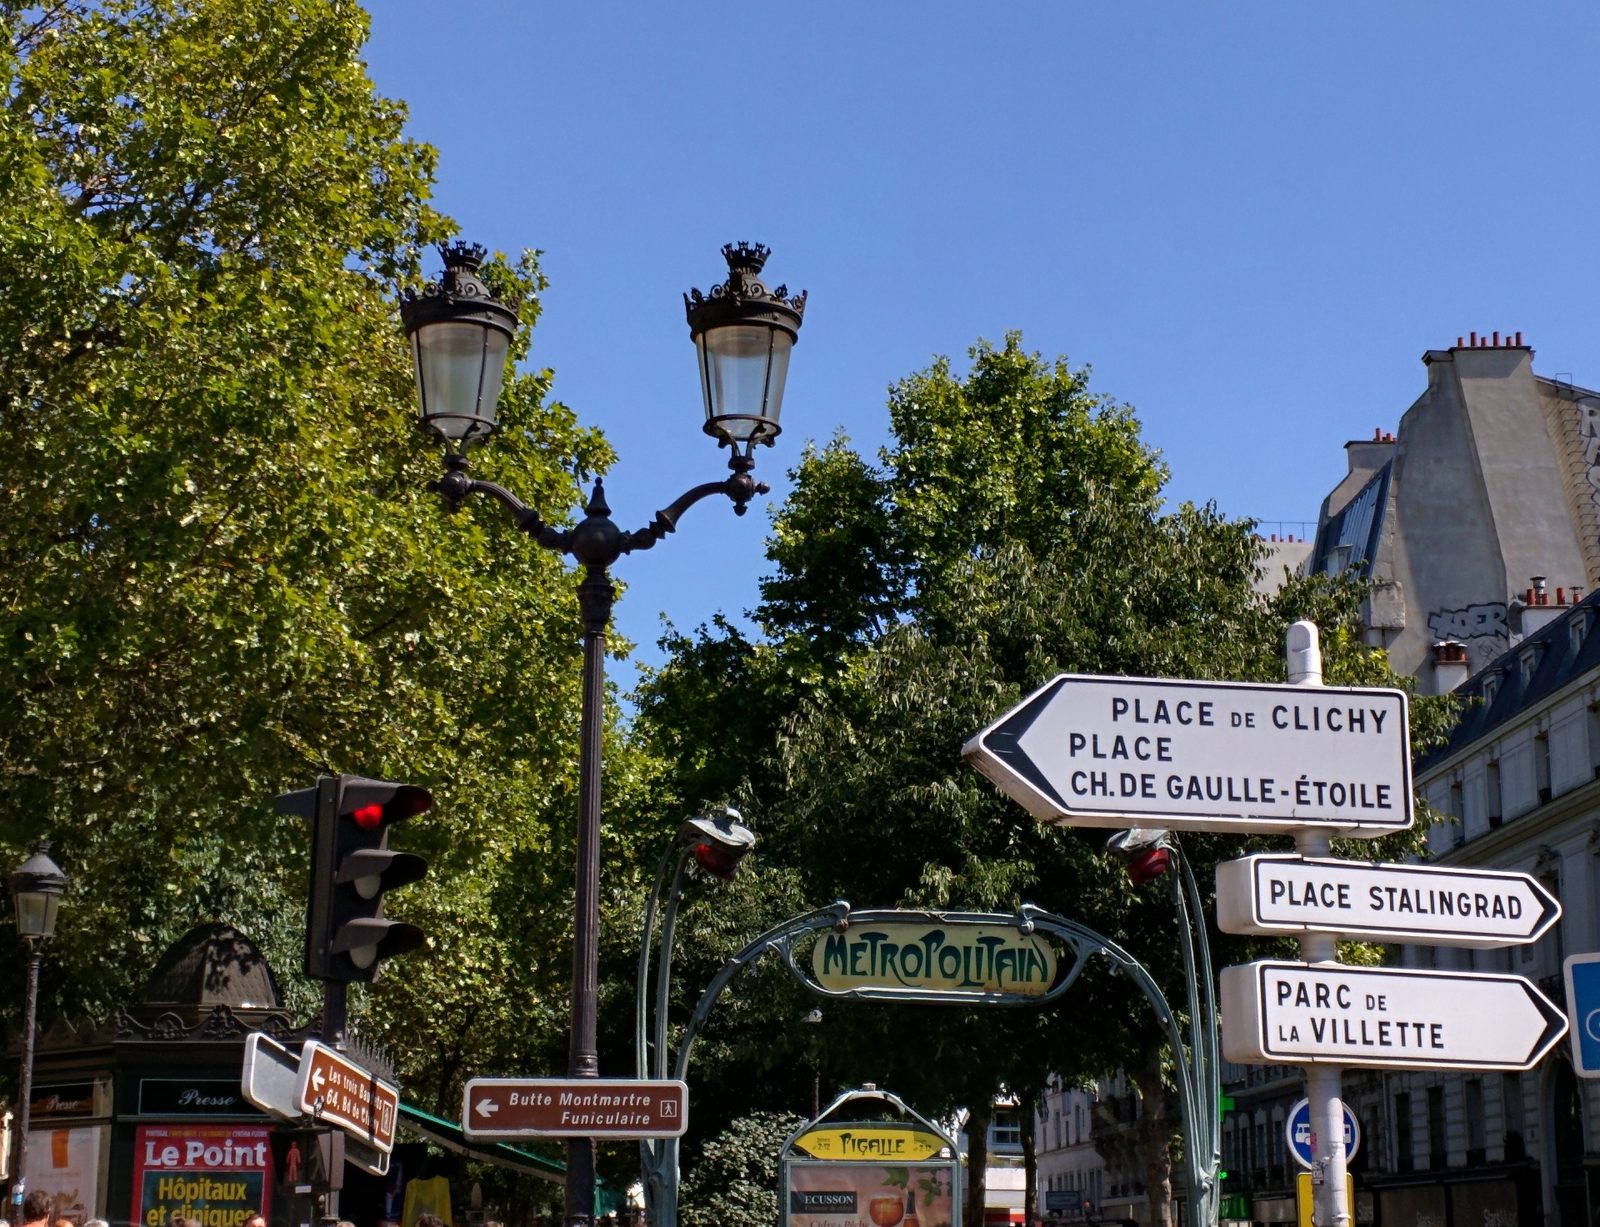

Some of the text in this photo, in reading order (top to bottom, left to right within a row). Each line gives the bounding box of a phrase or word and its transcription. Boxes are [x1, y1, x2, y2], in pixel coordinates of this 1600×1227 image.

[1112, 697, 1387, 734] PLACE DE CLICHY
[1070, 732, 1173, 762] PLACE
[1270, 879, 1523, 920] PLACE STALINGRAD
[823, 929, 1048, 988] METROPOLITAIN
[1277, 980, 1387, 1011] PARC DE
[1279, 1017, 1444, 1049] LA VILLETTE
[329, 1066, 341, 1085] Les
[343, 1074, 358, 1096] trois
[178, 1088, 238, 1106] Presse
[342, 1095, 352, 1114] Bd
[352, 1102, 360, 1120] de
[509, 1092, 651, 1106] Butte Montmartre
[561, 1111, 650, 1125] Funiculaire
[144, 1139, 267, 1167] Le Point
[839, 1132, 905, 1156] PIGALLE
[158, 1177, 247, 1204] Hôpitaux
[805, 1194, 854, 1205] ECUSSON
[147, 1205, 167, 1227] et
